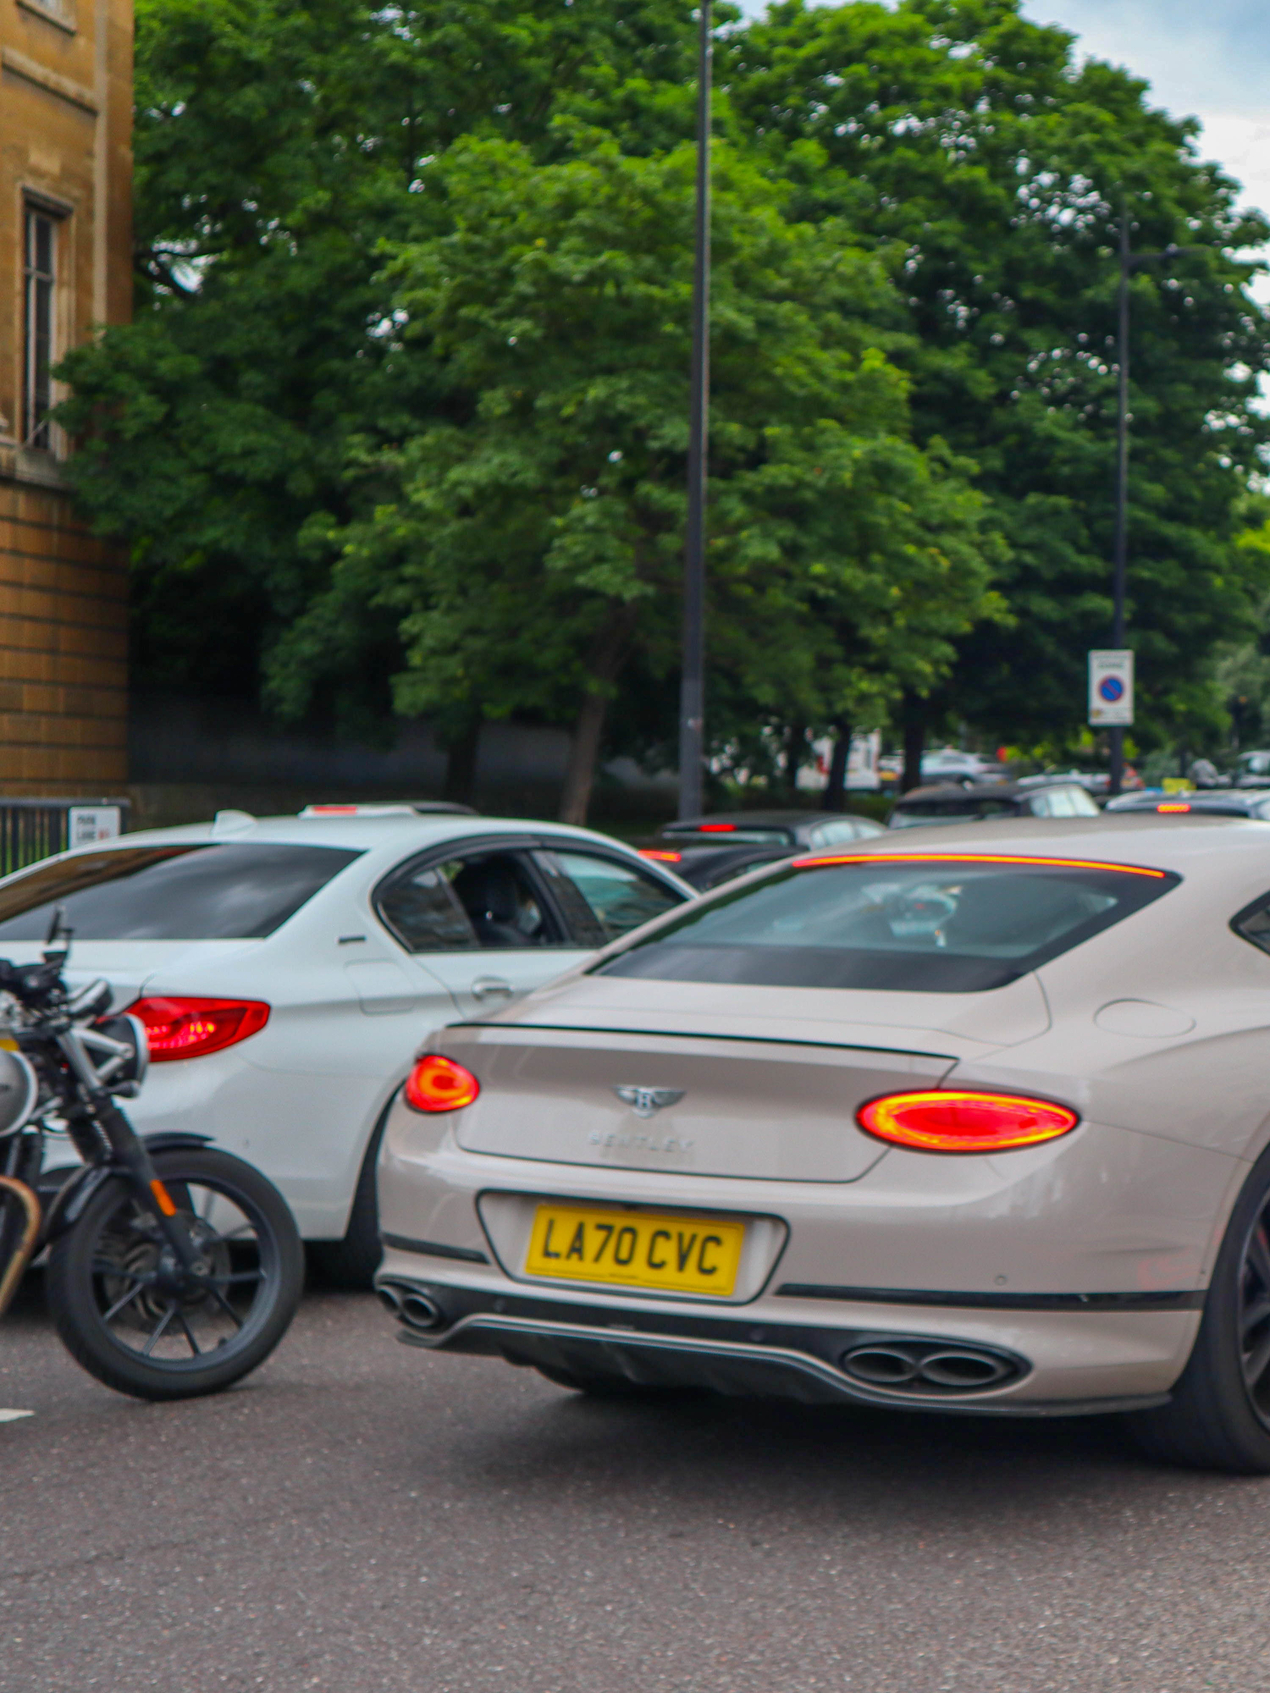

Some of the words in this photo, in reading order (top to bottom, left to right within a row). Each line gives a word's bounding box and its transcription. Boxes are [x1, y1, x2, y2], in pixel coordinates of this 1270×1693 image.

[588, 1131, 696, 1153] BENTLEY
[542, 1217, 638, 1267] LA70
[646, 1229, 723, 1276] CVC
